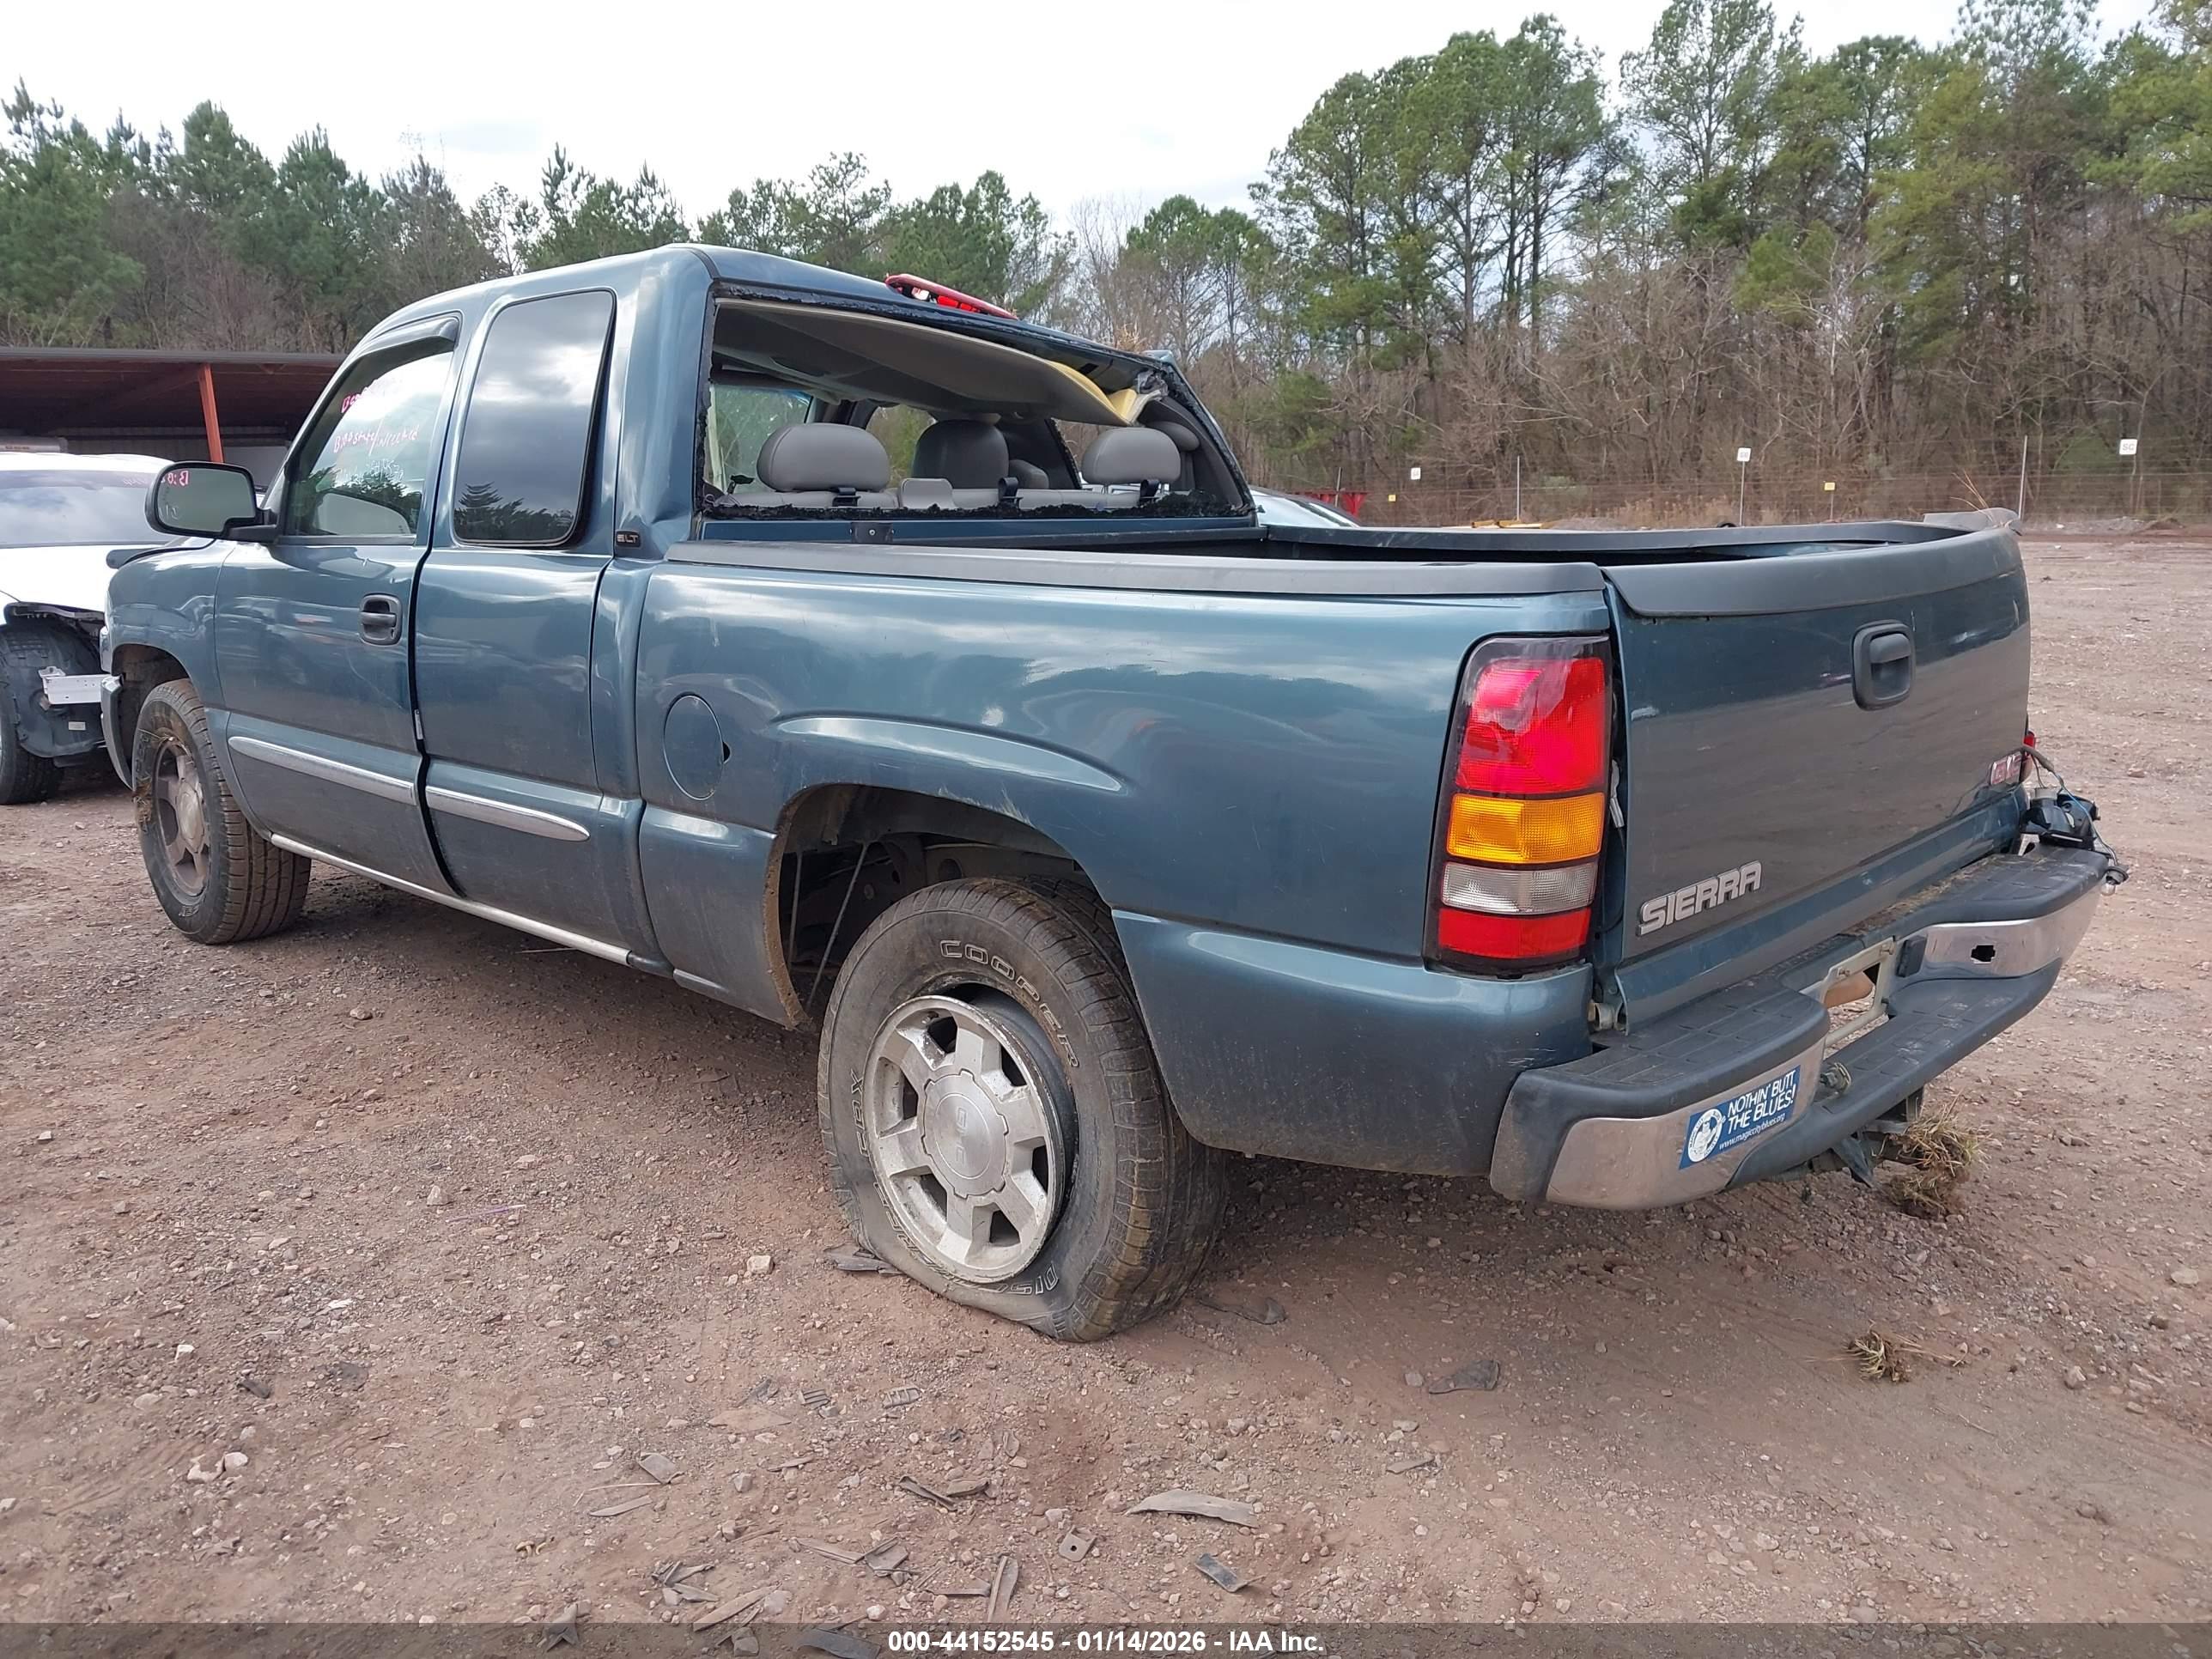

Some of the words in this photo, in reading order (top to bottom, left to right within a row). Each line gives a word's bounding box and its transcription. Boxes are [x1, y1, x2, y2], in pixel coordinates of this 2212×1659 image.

[617, 534, 639, 544] SLT
[1637, 860, 1761, 936] SIERRA
[940, 939, 1079, 1067] COOPER
[1728, 1084, 1771, 1118] NOTHIN'
[1771, 1070, 1796, 1097] BUTT
[1728, 1109, 1753, 1134] THE
[1753, 1084, 1796, 1121] BLUES!
